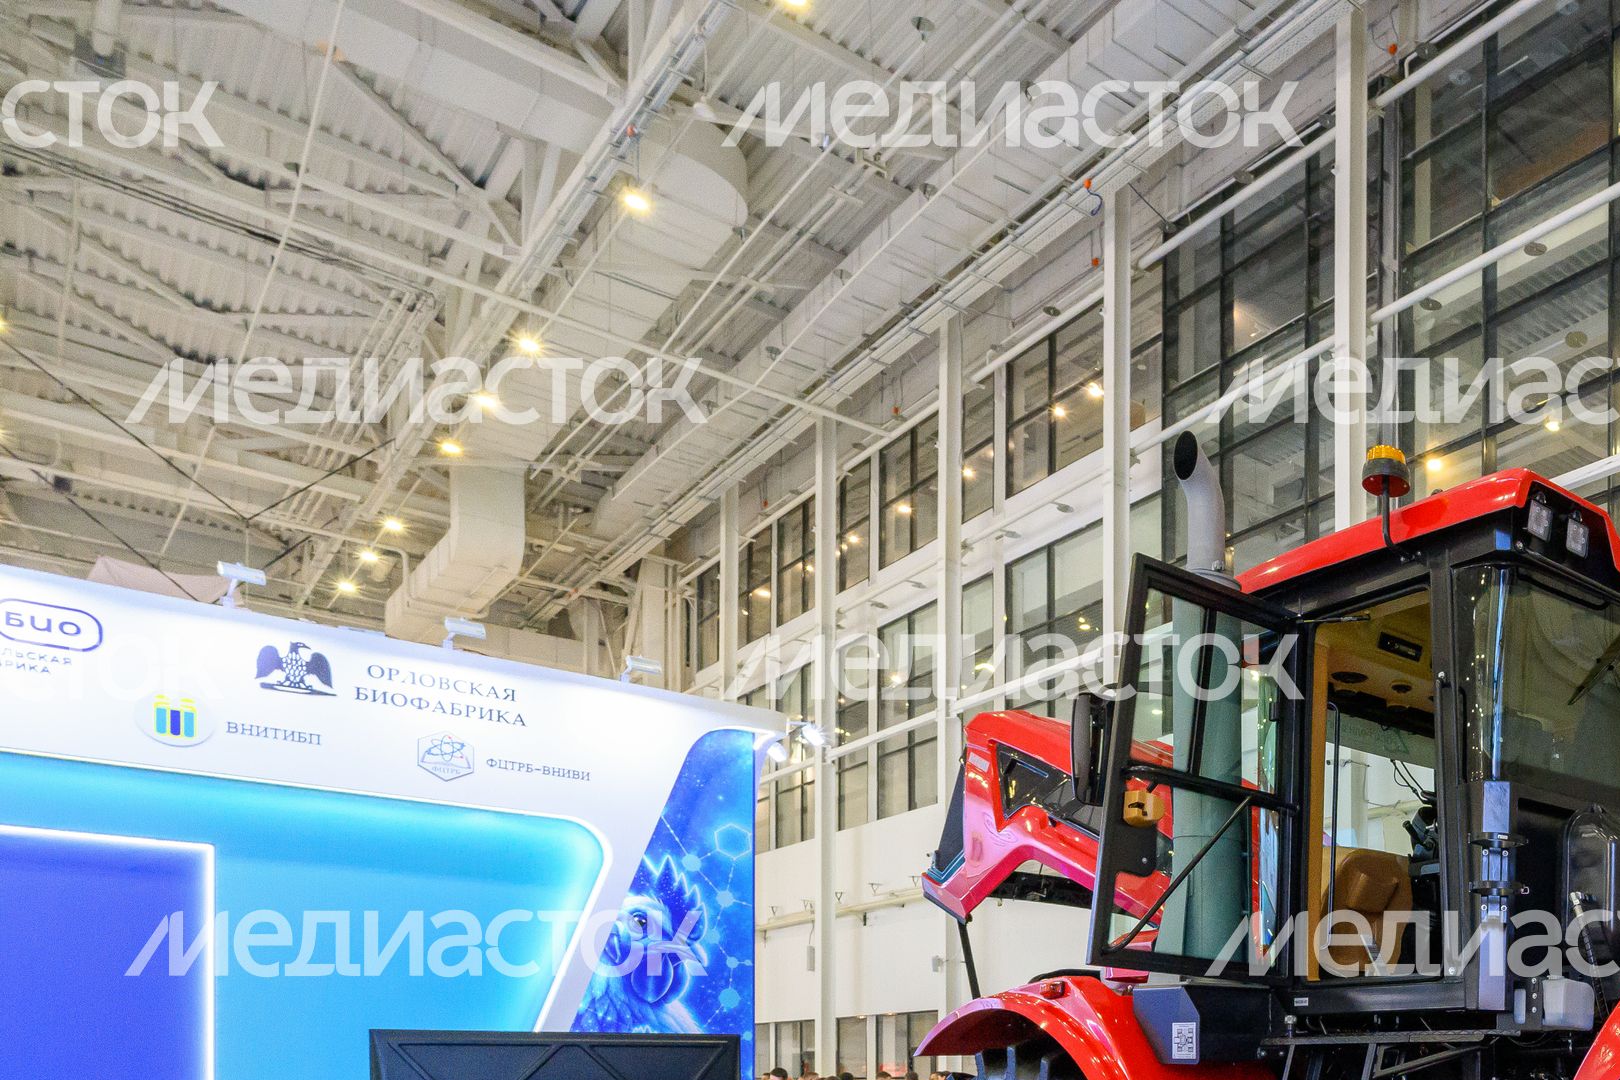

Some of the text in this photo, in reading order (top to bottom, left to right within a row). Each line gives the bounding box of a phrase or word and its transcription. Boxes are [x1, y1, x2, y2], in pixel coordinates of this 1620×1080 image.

[0, 659, 51, 675] РИКА
[366, 663, 517, 703] ОРЛОВСКАЯ
[353, 685, 528, 728] БИОФАБРИКА
[225, 720, 323, 747] ВНИТИБП
[485, 757, 592, 782] ФЦТРБ-ВНИВИ
